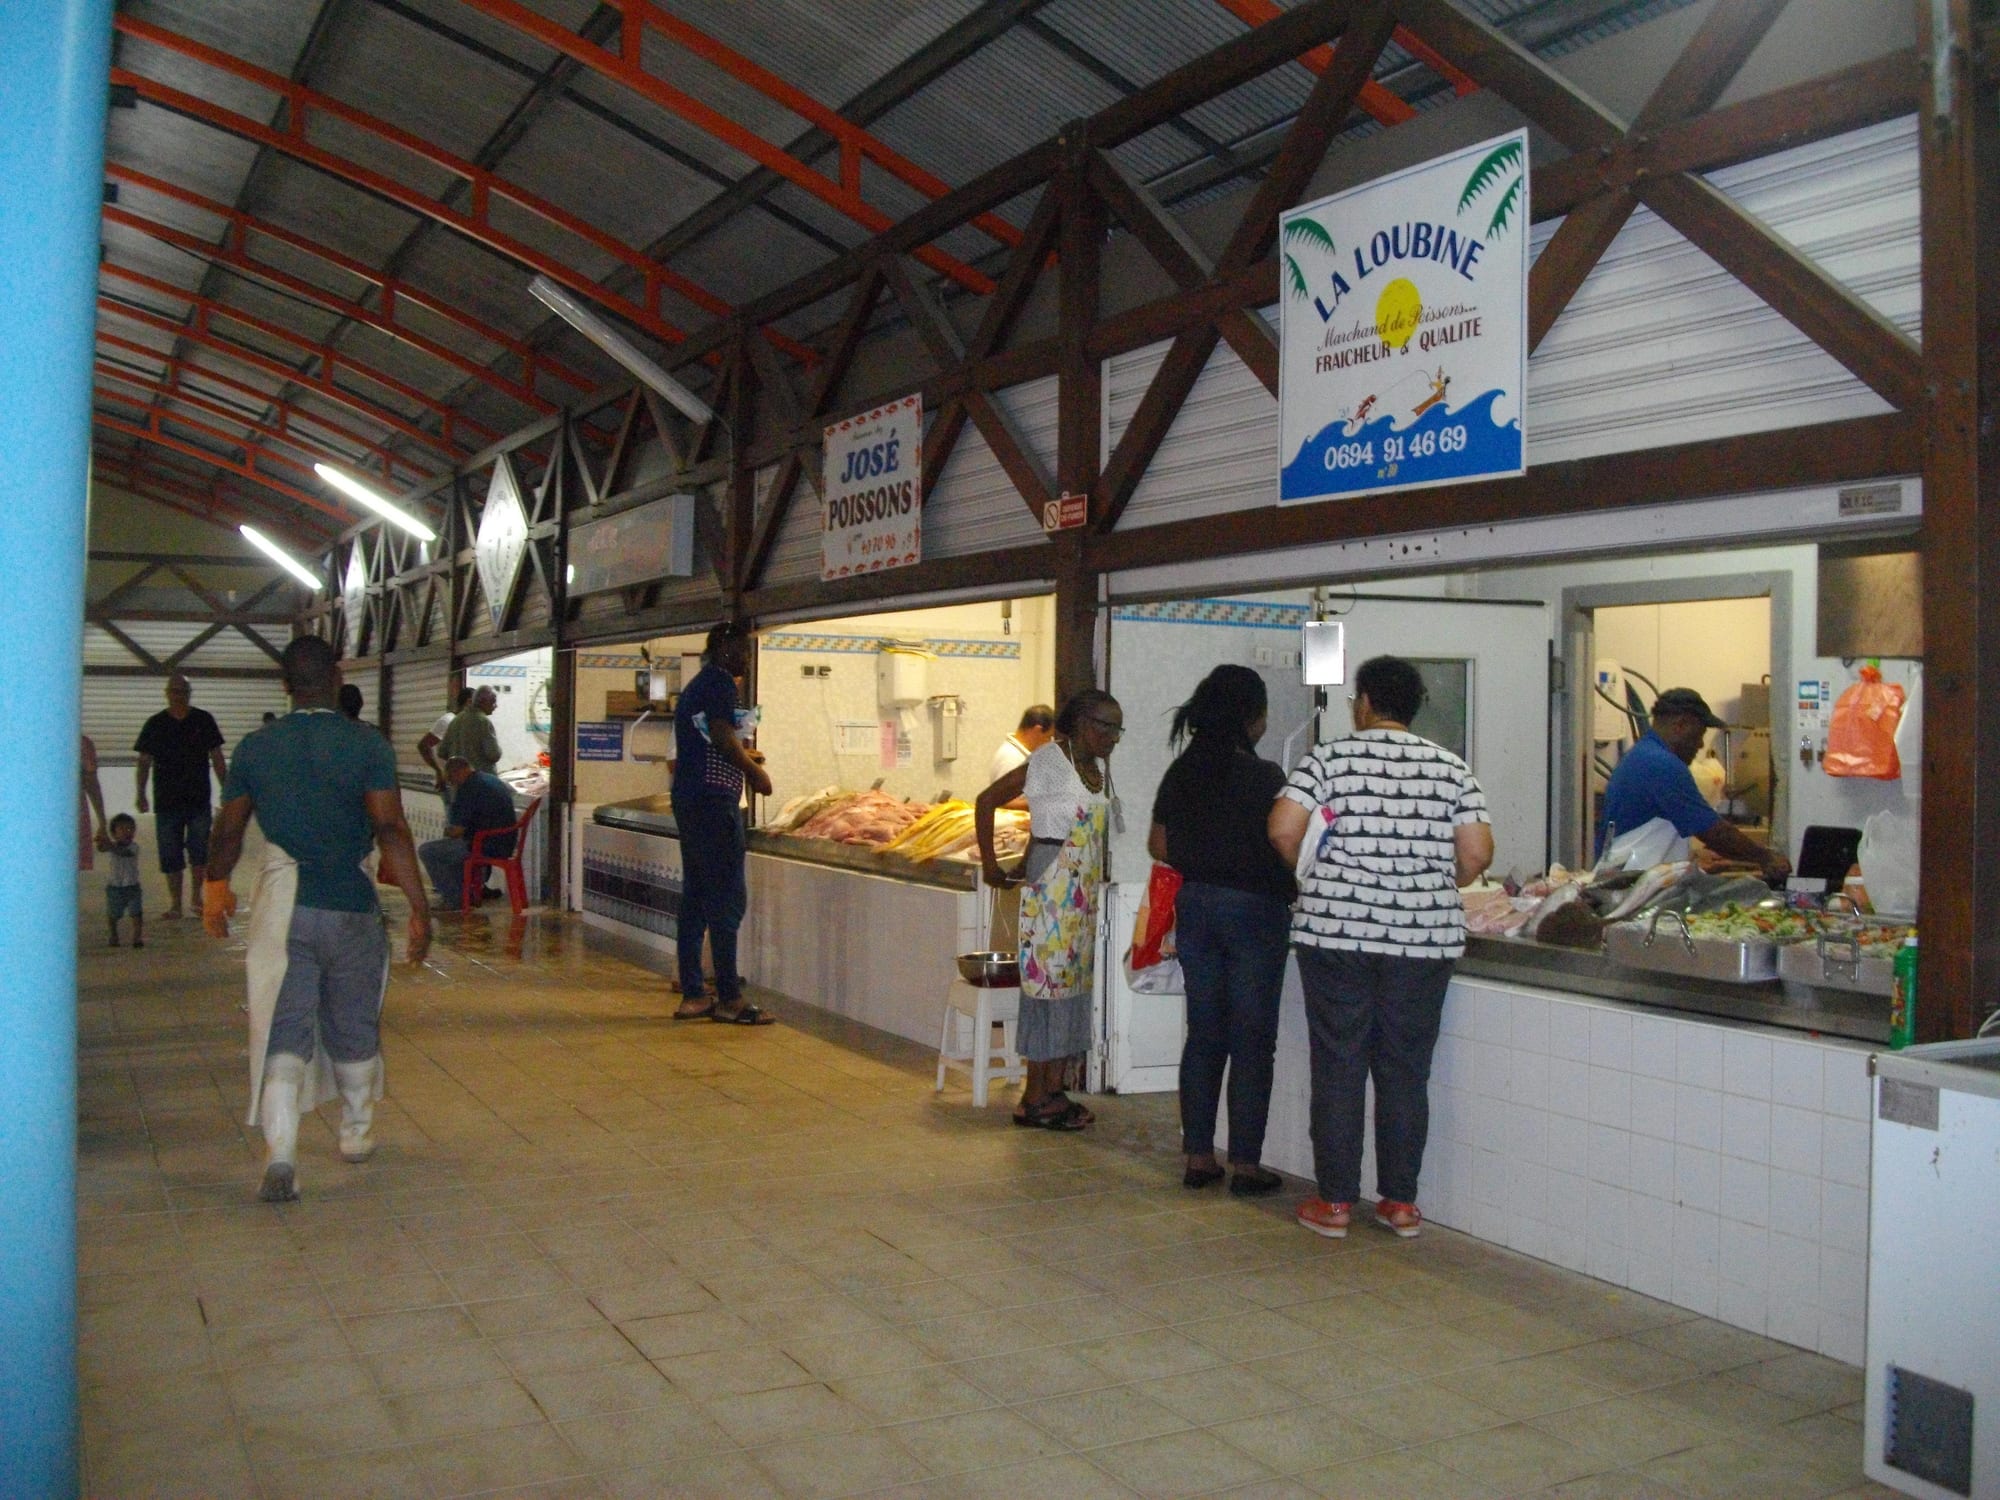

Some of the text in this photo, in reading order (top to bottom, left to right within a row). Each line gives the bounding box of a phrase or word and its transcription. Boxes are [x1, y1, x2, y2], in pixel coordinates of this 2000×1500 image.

[1314, 221, 1485, 323] LA LOUBINE
[1316, 317, 1482, 374] FRAICHEUR & QUALITE
[1317, 313, 1387, 351] Marchand
[1390, 312, 1404, 332] de
[841, 427, 900, 484] JOSÉ
[1324, 424, 1468, 471] 0694 91 46 69
[828, 480, 912, 532] POISSONS
